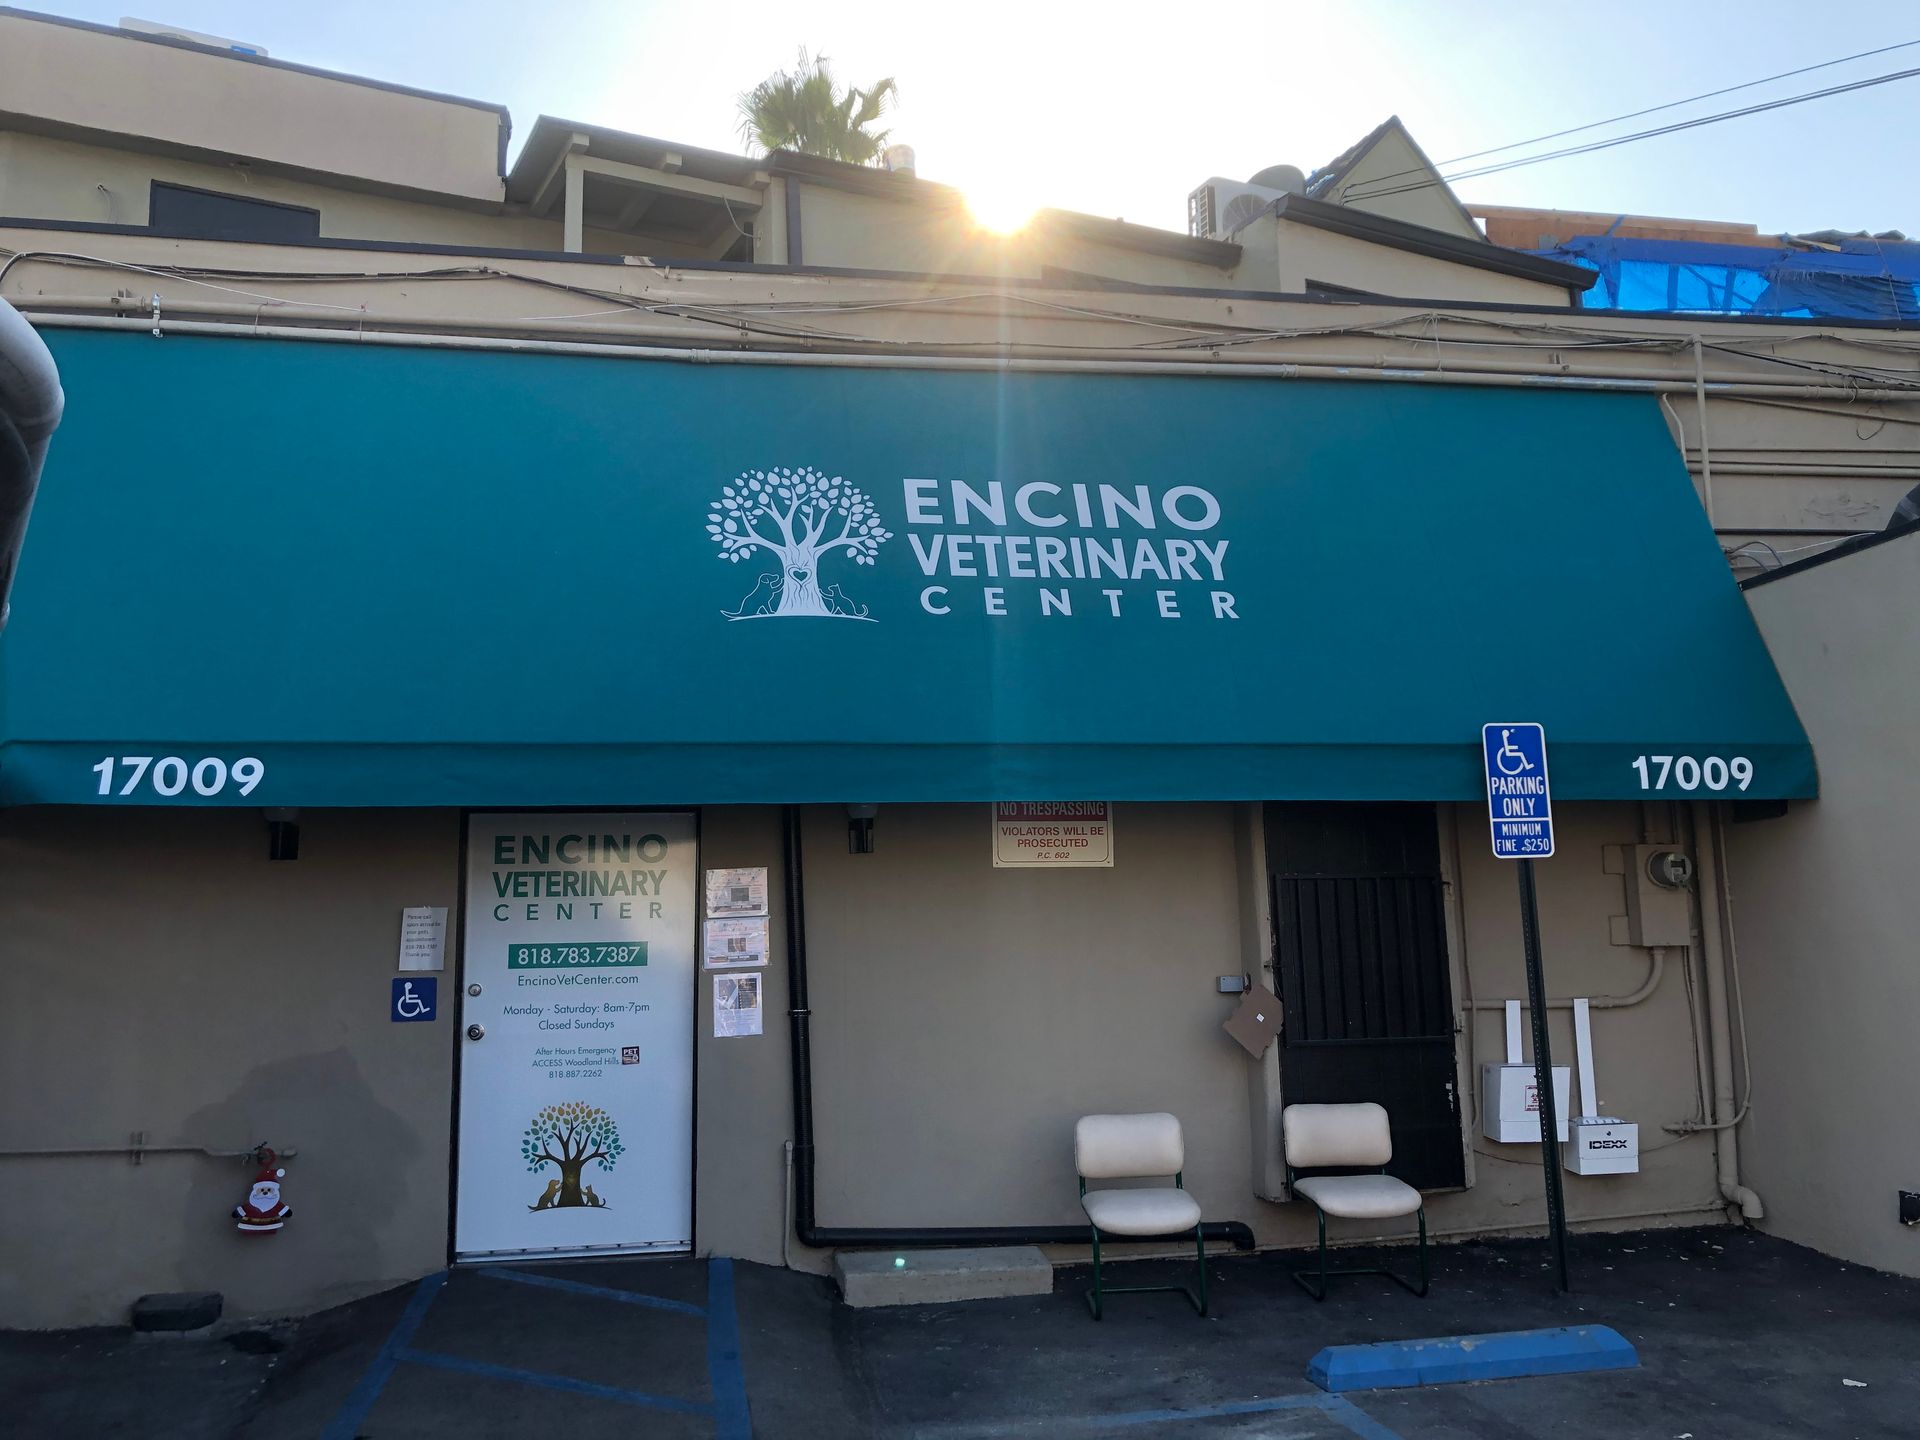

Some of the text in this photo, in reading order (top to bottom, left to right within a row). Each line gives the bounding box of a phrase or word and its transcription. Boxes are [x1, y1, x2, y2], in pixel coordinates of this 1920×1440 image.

[902, 478, 1221, 531] ENCINO
[907, 533, 1230, 581] VETERINARY
[920, 585, 1240, 619] CENTER
[92, 755, 265, 797] 17009
[1631, 755, 1754, 791] 17009
[1491, 776, 1545, 795] PARKING
[999, 802, 1105, 816] NO TRESPASSING
[1503, 798, 1535, 816] ONLY
[1001, 826, 1104, 836] VIOLATORS WILL BE
[1502, 823, 1542, 836] MINIMUM
[493, 833, 668, 865] ENCINO
[1017, 838, 1089, 848] PROSECUTED
[1496, 838, 1549, 852] FINE $250
[492, 869, 668, 898] VETERINARY
[493, 902, 663, 922] CENTER
[518, 946, 641, 966] 818.783.7387
[518, 974, 639, 987] EncinoVetCenter.com
[503, 1003, 544, 1017] Monday
[554, 1003, 601, 1015] Saturday:
[603, 1002, 650, 1014] 8am-7pm
[538, 1018, 615, 1030] Closed Sundays
[535, 1046, 617, 1056] After Hours Emergency
[532, 1057, 620, 1067] ACCESS Woodland Hills
[1589, 1140, 1628, 1149] IDEXX
